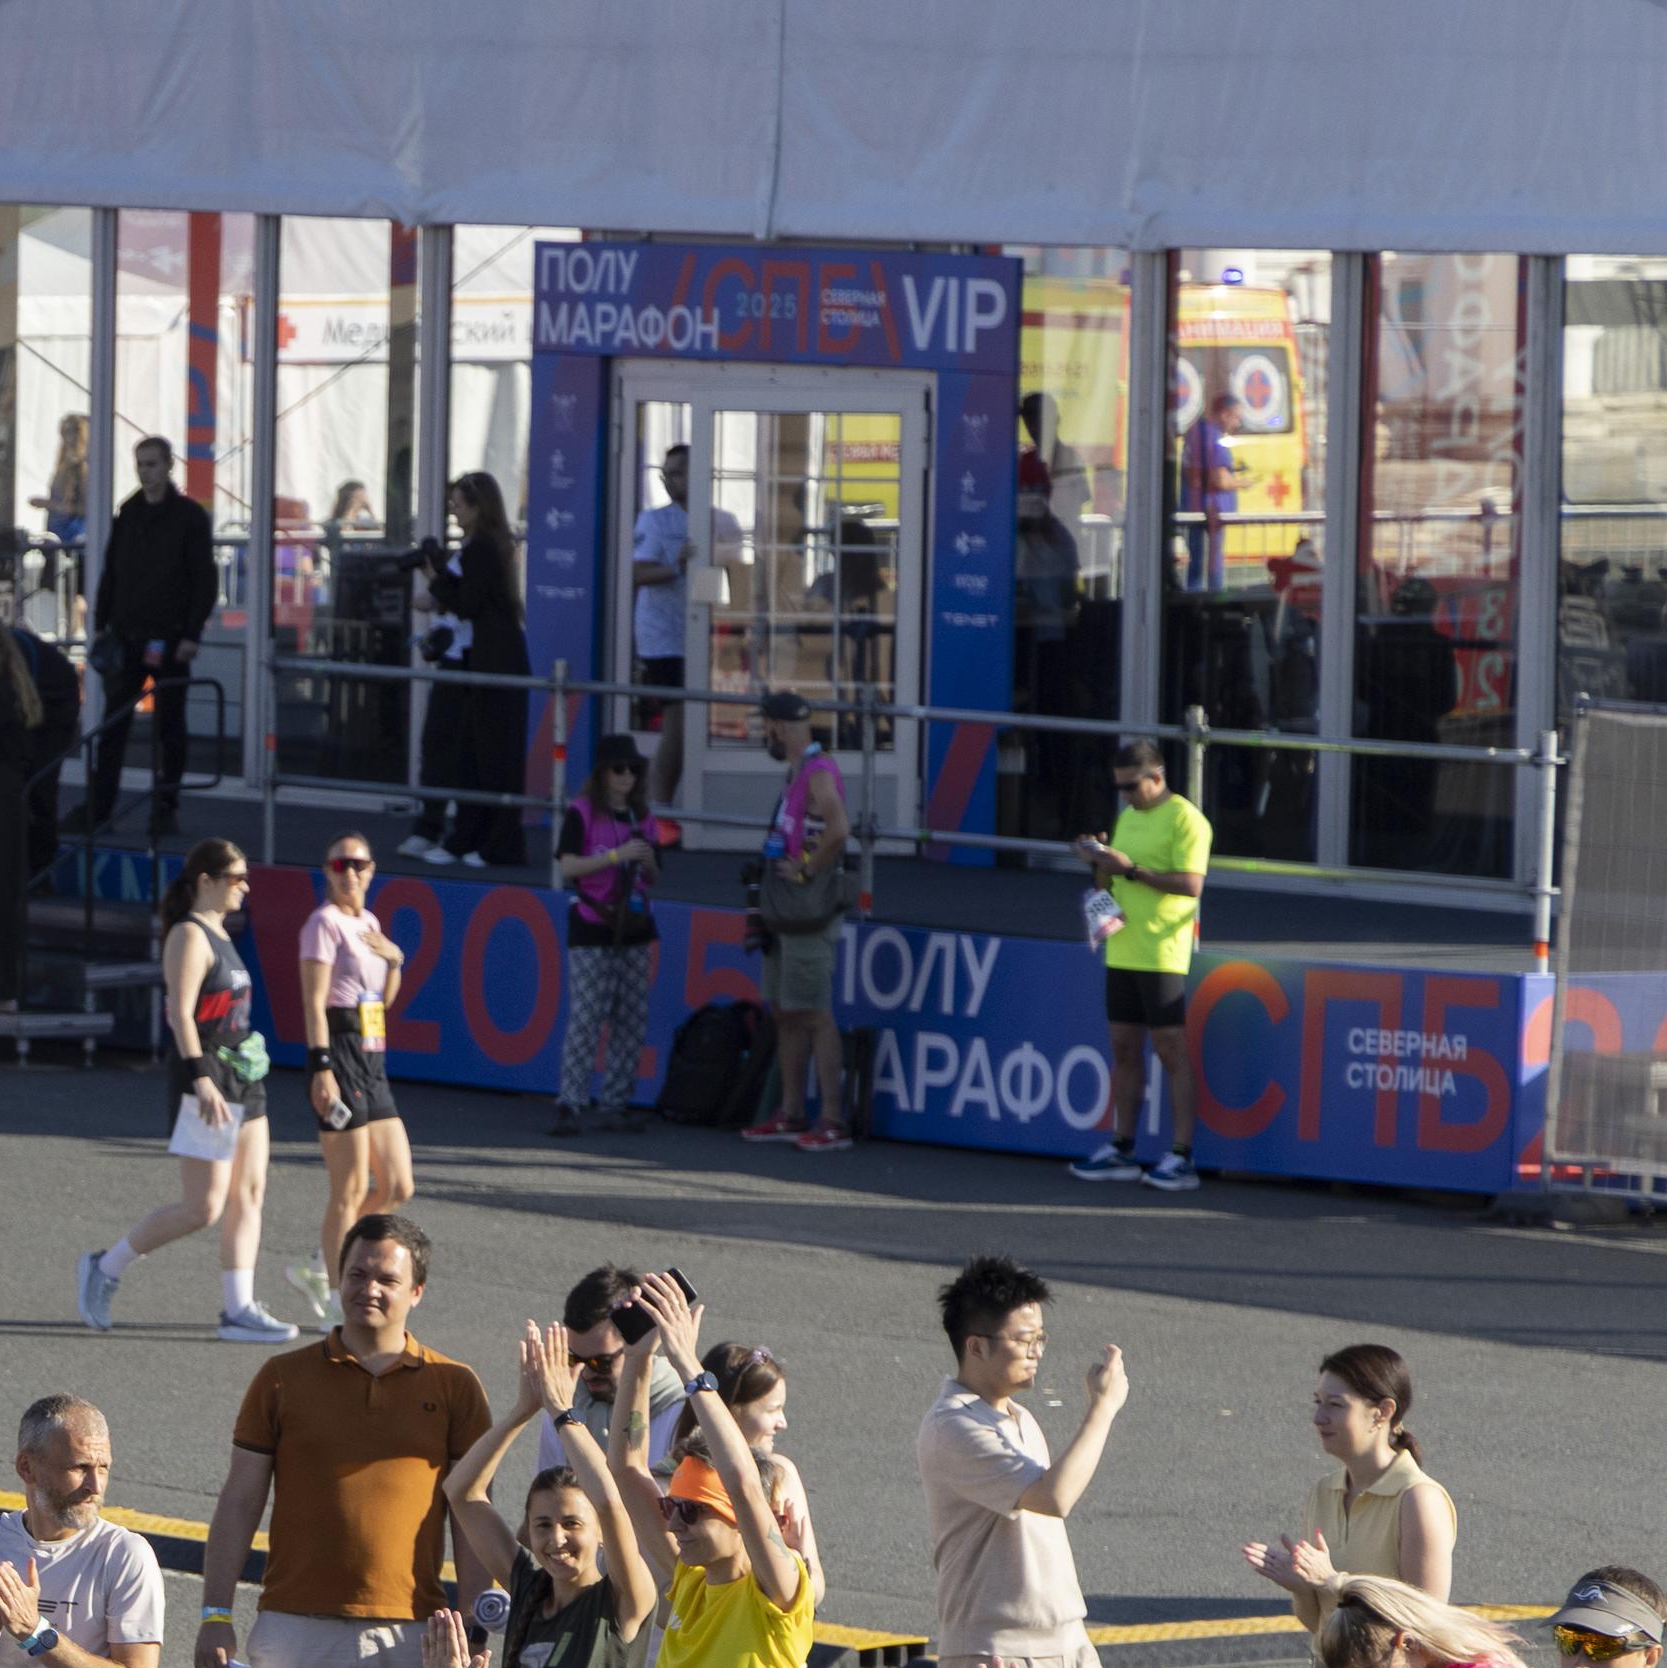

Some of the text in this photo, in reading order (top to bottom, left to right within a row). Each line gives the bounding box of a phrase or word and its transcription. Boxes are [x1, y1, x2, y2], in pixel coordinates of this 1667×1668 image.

[540, 247, 640, 293] ПОЛУ
[538, 300, 721, 350] МАРАФОН
[736, 291, 799, 320] 2025
[901, 273, 1007, 354] VIP
[1346, 1026, 1468, 1061] СЕВЕРНАЯ
[867, 1027, 1161, 1137] АРАФОН
[1345, 1060, 1457, 1098] СТОЛИЦА
